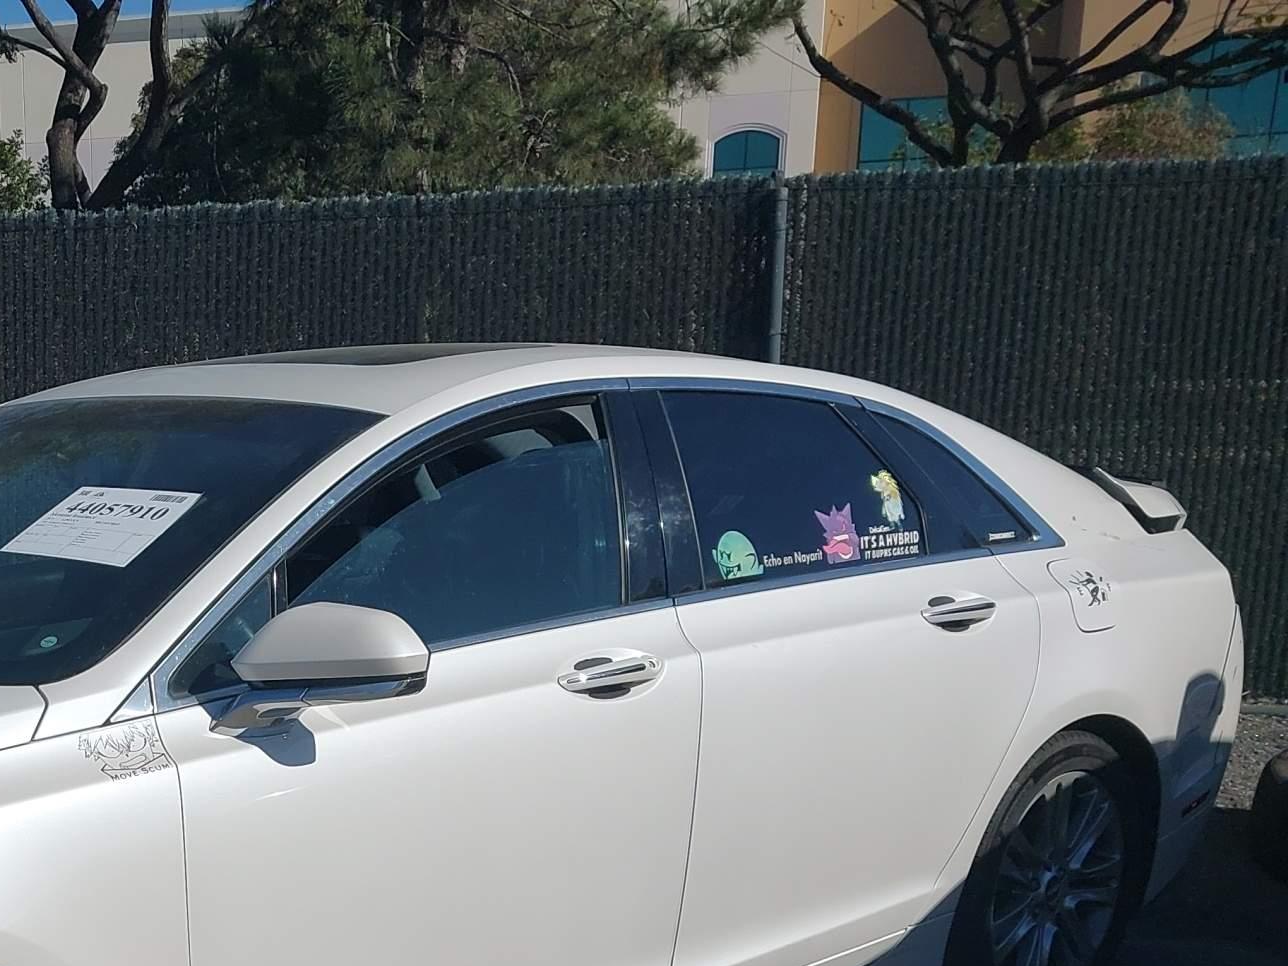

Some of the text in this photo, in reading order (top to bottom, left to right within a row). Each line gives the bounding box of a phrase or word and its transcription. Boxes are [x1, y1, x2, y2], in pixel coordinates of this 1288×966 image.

[65, 501, 170, 521] 44057910
[879, 535, 885, 547] A
[886, 531, 919, 546] HYBRID
[763, 549, 823, 567] Echo en Nayarit
[865, 550, 871, 560] IT
[111, 763, 170, 782] MOVE SCUM
